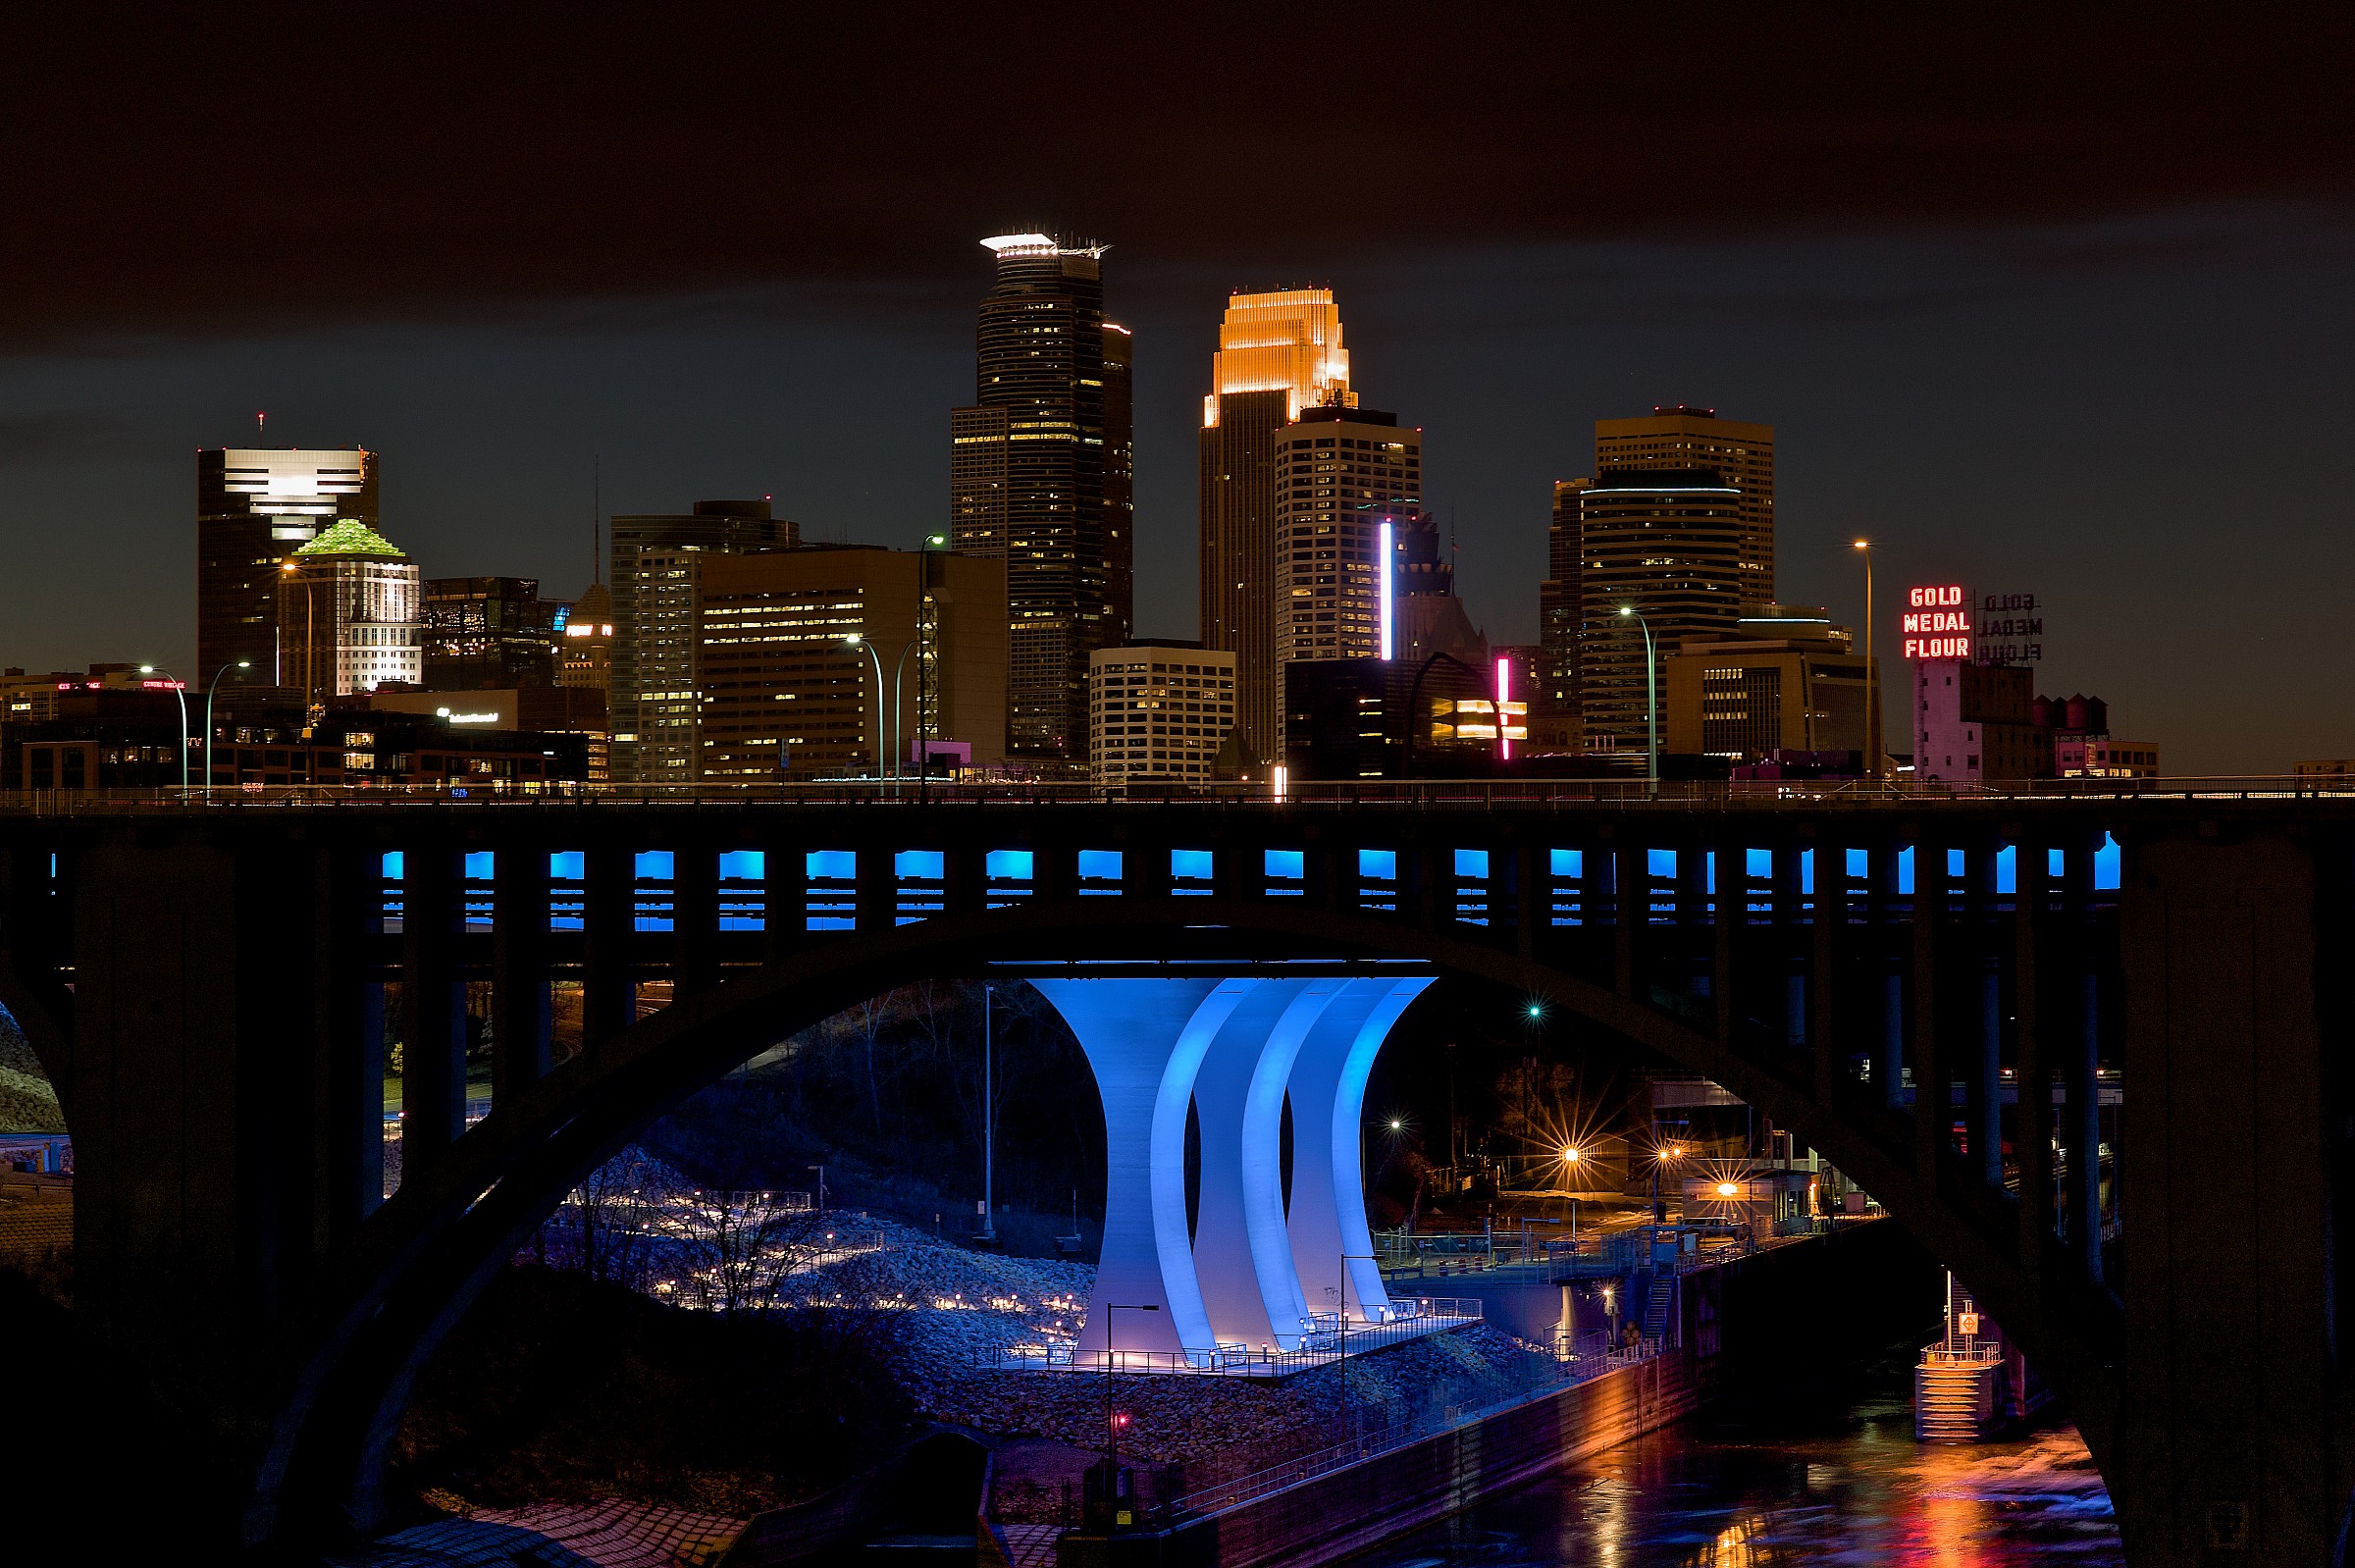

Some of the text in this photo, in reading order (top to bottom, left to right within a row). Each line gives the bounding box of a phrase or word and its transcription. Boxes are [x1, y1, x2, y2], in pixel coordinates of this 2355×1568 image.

[1911, 587, 1962, 606] GOLD
[1904, 612, 1970, 633] MEDAL
[1906, 638, 1968, 658] FLOUR
